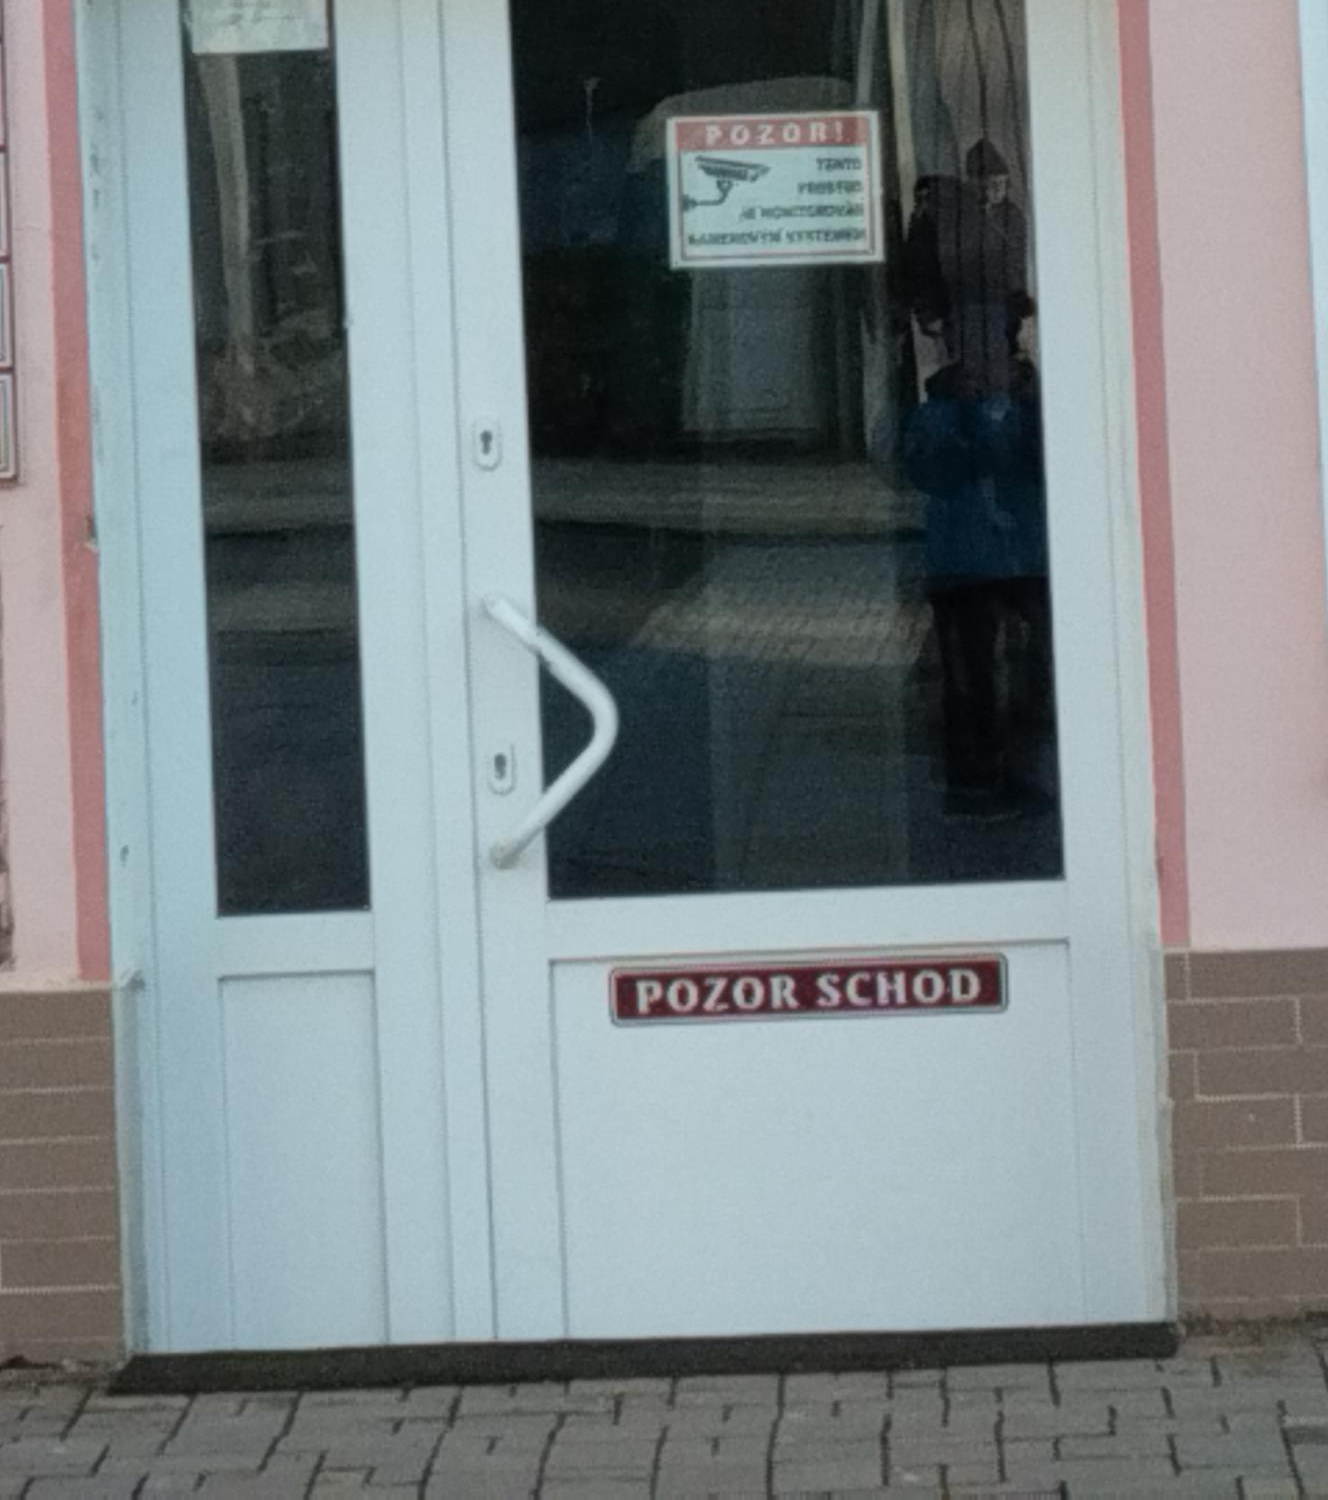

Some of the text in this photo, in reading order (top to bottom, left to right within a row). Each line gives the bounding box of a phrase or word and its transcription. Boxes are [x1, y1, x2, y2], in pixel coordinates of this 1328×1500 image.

[704, 121, 844, 146] POZOR!
[635, 968, 981, 1014] POZOR SCHOD
